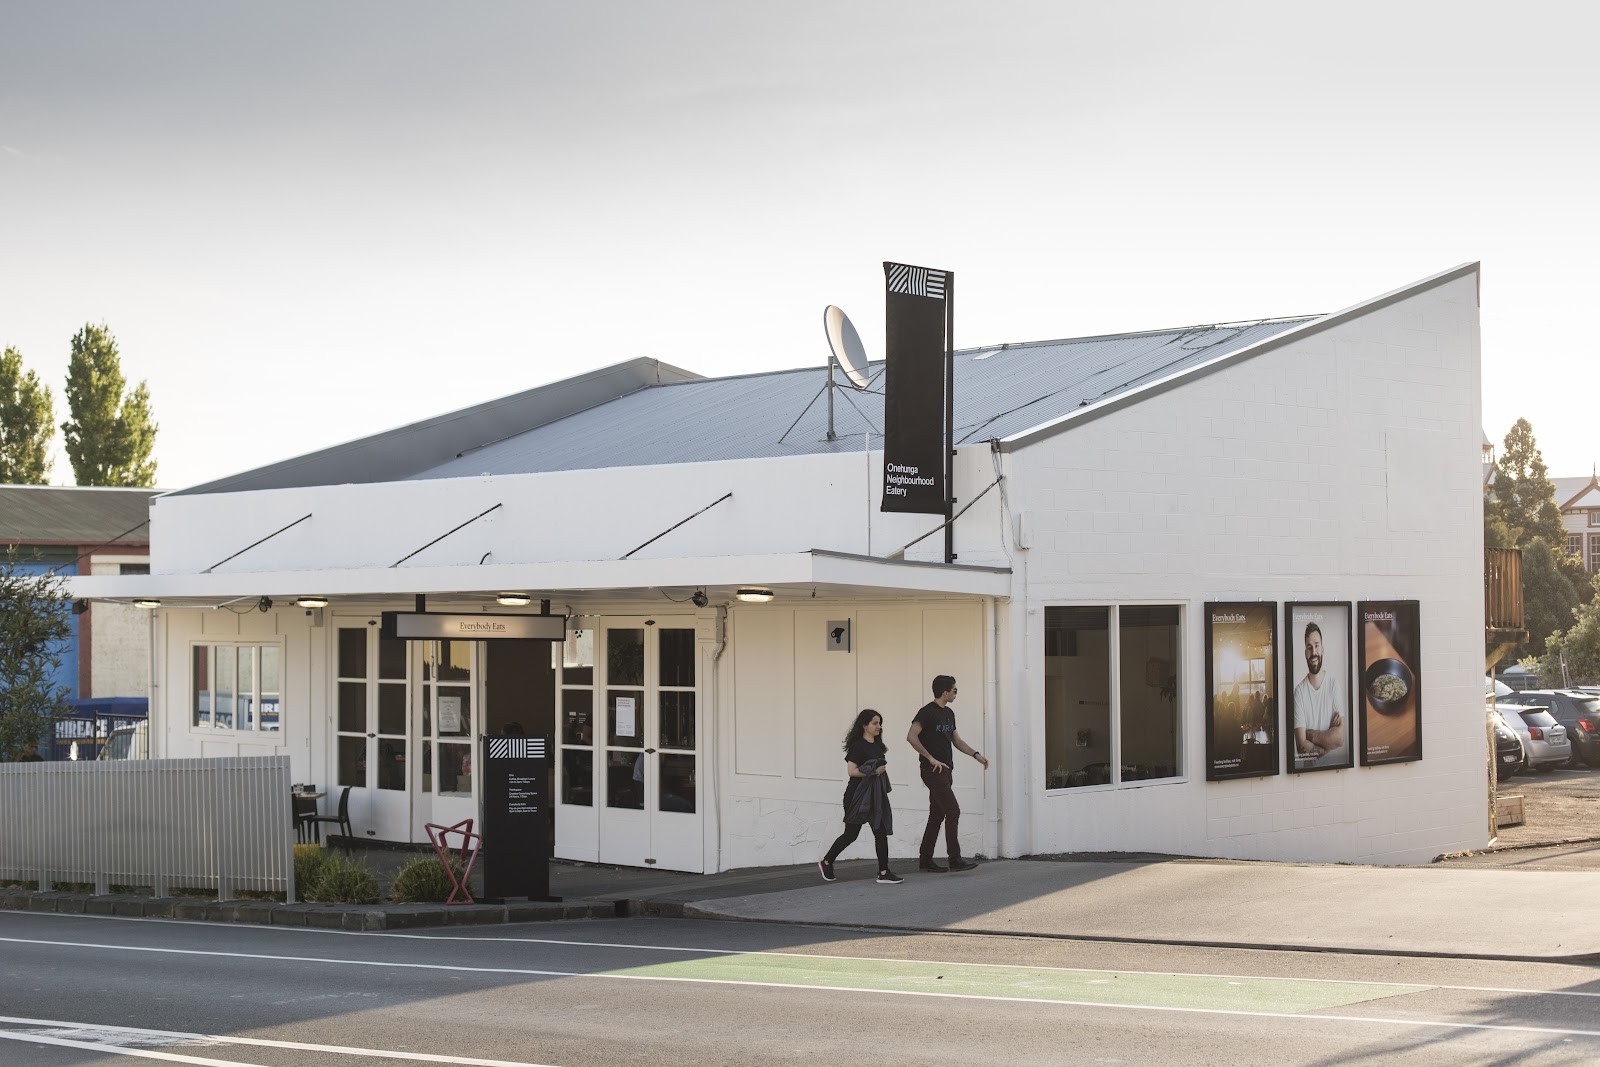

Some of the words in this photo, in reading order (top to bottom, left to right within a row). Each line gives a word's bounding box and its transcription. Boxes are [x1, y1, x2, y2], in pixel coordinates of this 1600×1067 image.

[887, 463, 919, 475] Onehunga
[887, 474, 935, 486] Neighbourhood
[886, 486, 907, 497] Eatery
[1212, 613, 1235, 622] Everybody
[460, 622, 491, 631] Everybody
[493, 622, 506, 630] Eats
